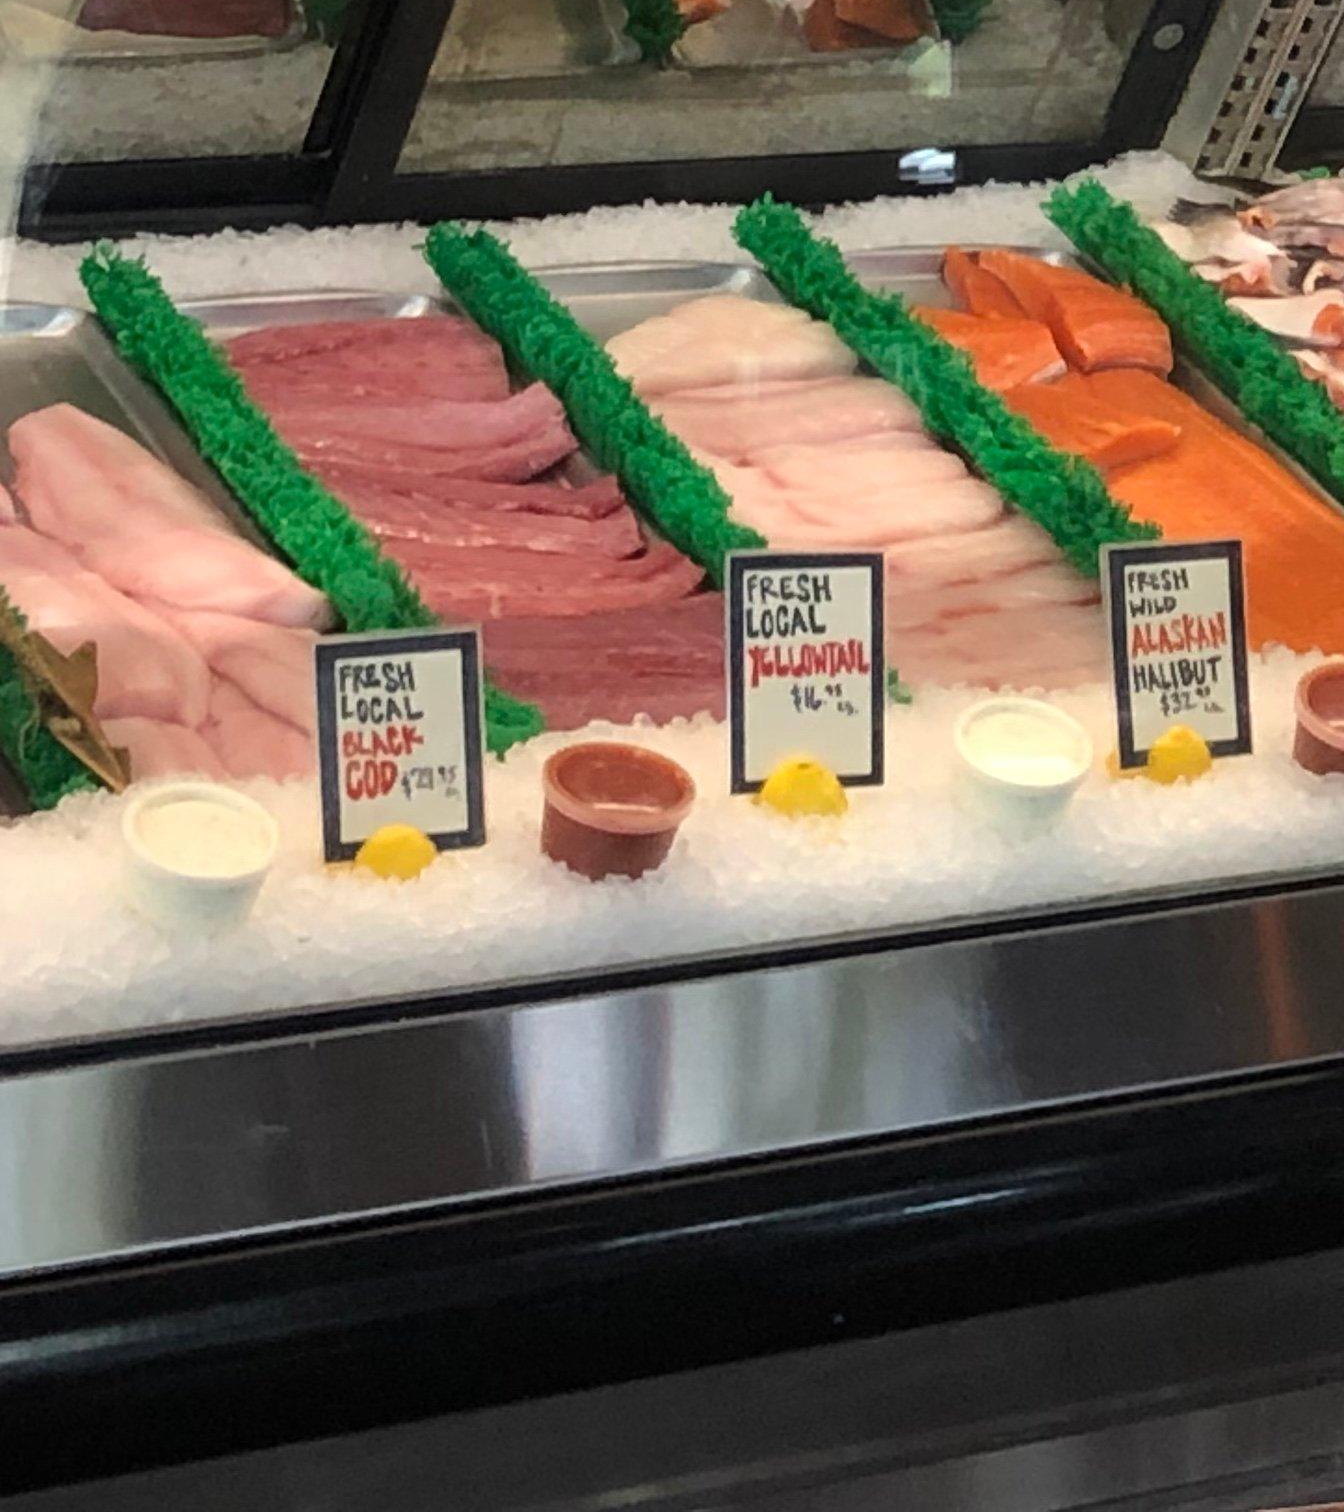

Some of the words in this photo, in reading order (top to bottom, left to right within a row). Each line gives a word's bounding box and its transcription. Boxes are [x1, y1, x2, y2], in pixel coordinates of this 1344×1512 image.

[745, 573, 832, 603] FRESH
[1127, 568, 1189, 594] FRESH
[746, 605, 826, 639] LOCAL
[1129, 595, 1177, 618] WILD
[1131, 611, 1227, 658] ALASKAN
[339, 661, 415, 694] FRESH
[748, 638, 871, 688] YELLOWTAIL
[1132, 656, 1222, 693] HALIBUT
[341, 695, 424, 724] LOCAL
[342, 725, 424, 758] BLACK
[345, 759, 398, 801] COD
